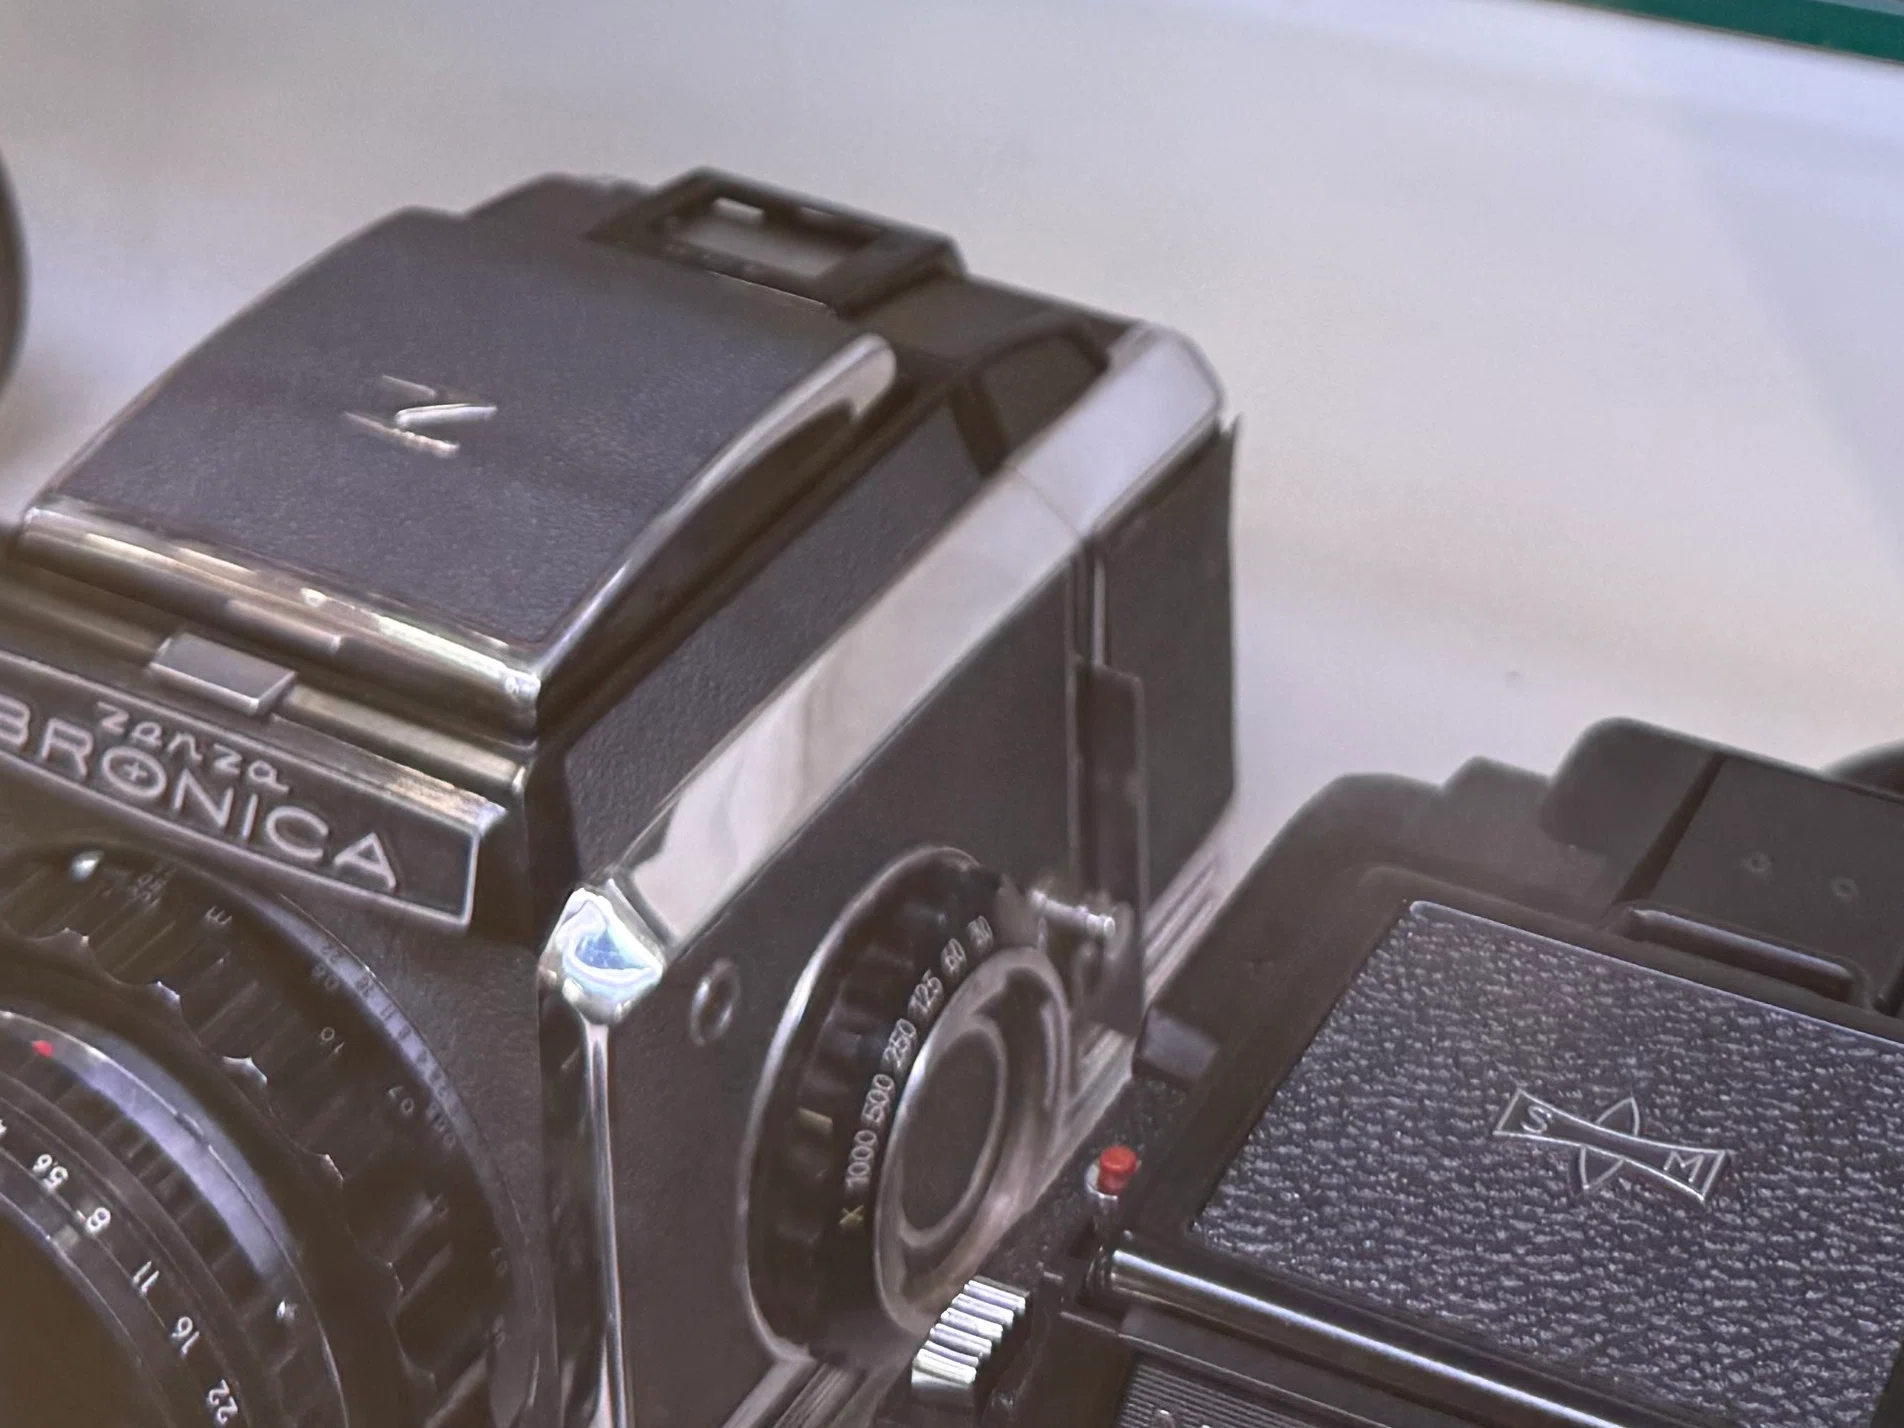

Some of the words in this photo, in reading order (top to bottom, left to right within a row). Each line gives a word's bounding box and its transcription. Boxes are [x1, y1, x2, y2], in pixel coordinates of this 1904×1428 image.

[907, 971, 944, 1021] 125
[883, 1017, 917, 1070] 250
[861, 1072, 896, 1126] 500
[844, 1128, 879, 1193] 1000
[85, 1206, 112, 1236] 8
[131, 1259, 161, 1298] 11
[170, 1315, 201, 1357] 16
[206, 1378, 239, 1425] 22
